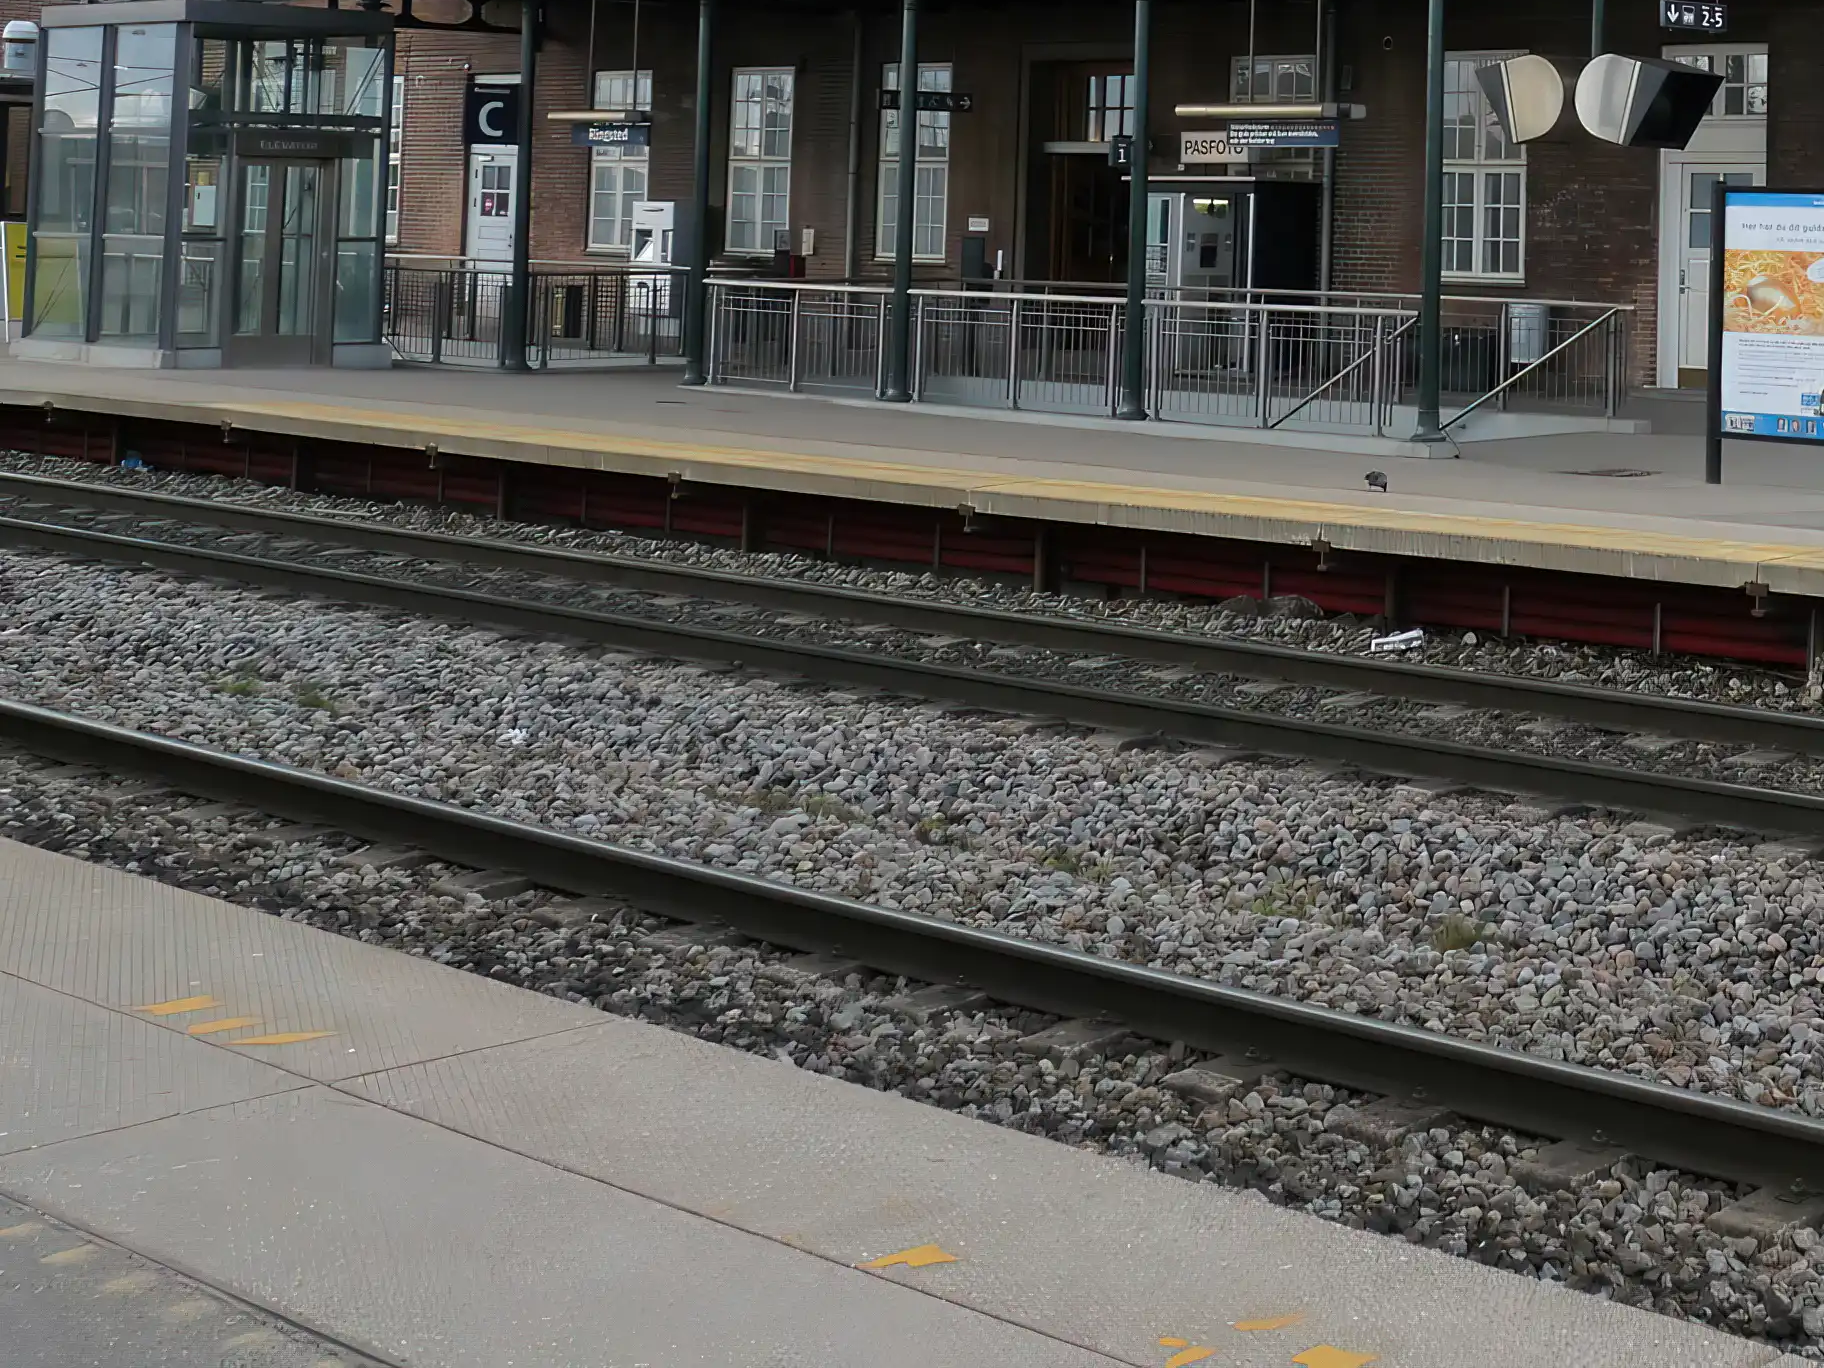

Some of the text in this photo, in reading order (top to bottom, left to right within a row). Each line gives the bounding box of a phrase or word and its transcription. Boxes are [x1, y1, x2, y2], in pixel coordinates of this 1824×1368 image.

[478, 101, 504, 137] C
[588, 127, 629, 141] Ringsted
[1118, 148, 1127, 163] 1
